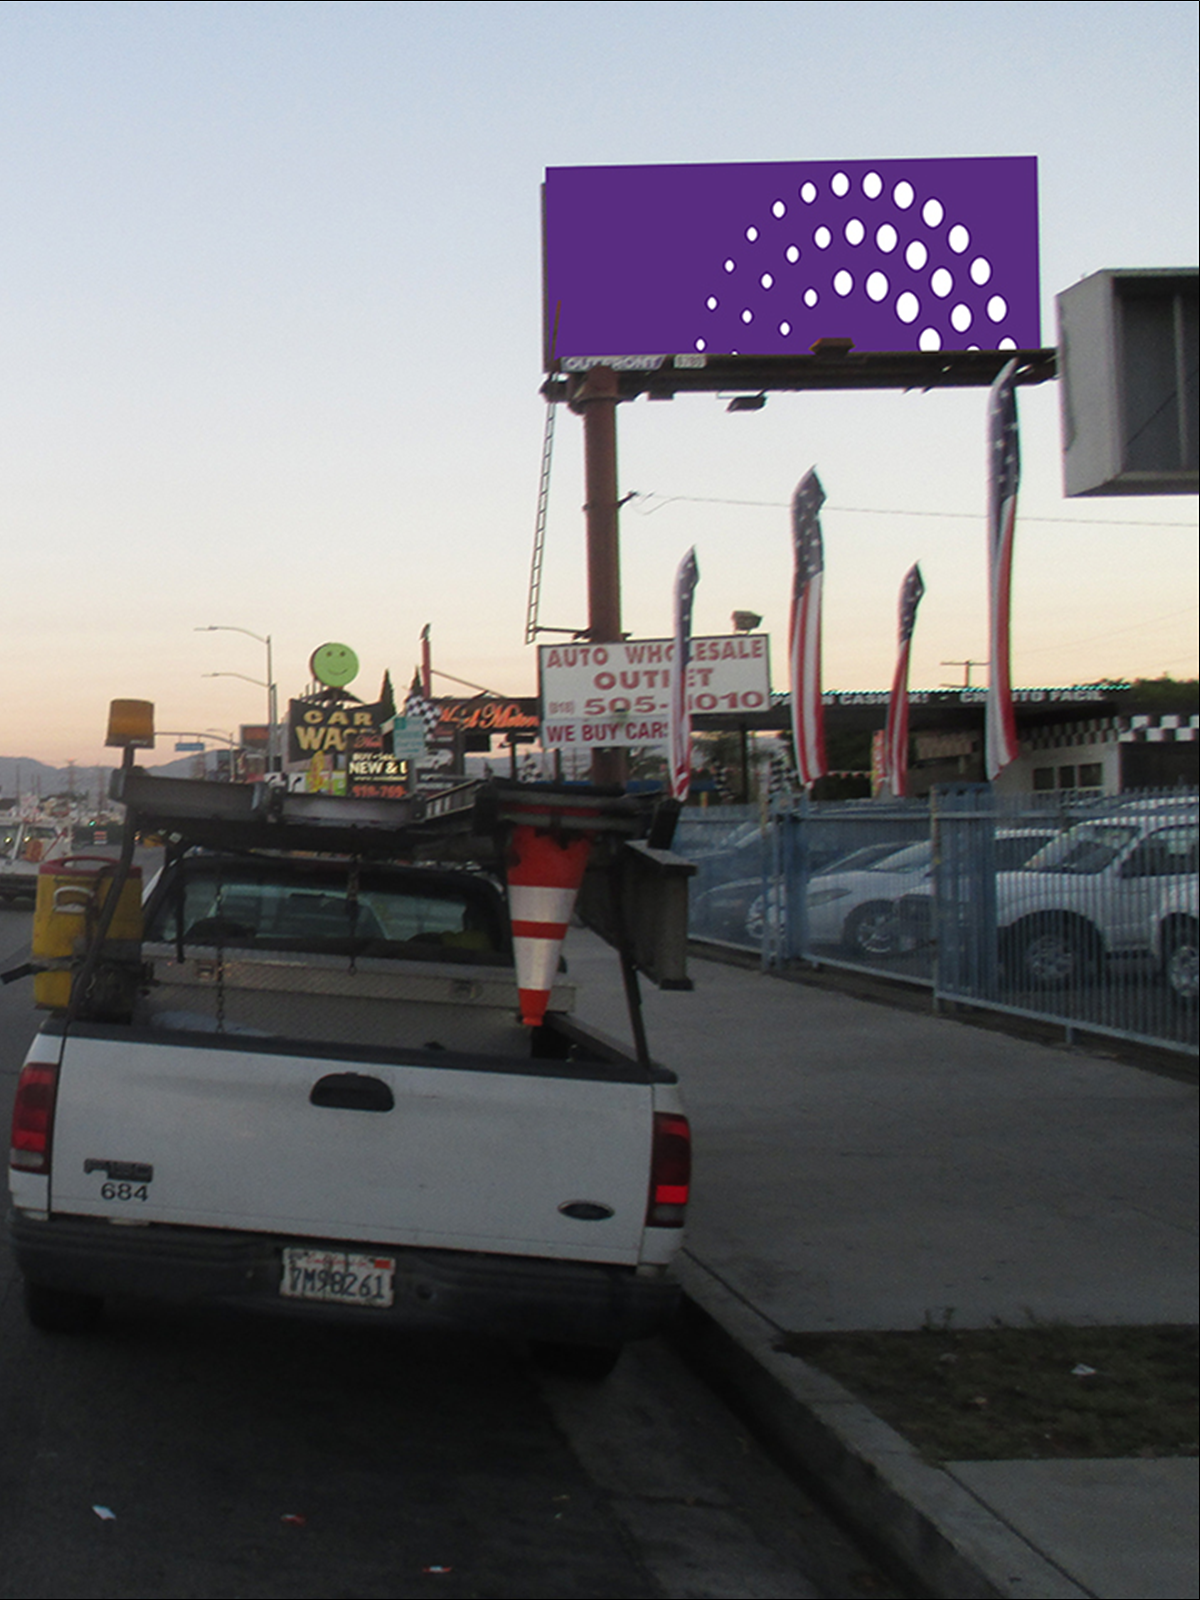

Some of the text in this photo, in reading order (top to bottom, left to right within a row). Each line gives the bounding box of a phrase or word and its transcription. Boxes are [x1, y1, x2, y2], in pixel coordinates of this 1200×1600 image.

[546, 639, 763, 669] AUTO WHOESALE
[303, 709, 373, 726] CAR
[295, 726, 377, 751] WA
[545, 725, 577, 743] WE
[581, 723, 619, 742] BUY
[349, 760, 385, 775] NEW
[101, 1182, 149, 1202] 684
